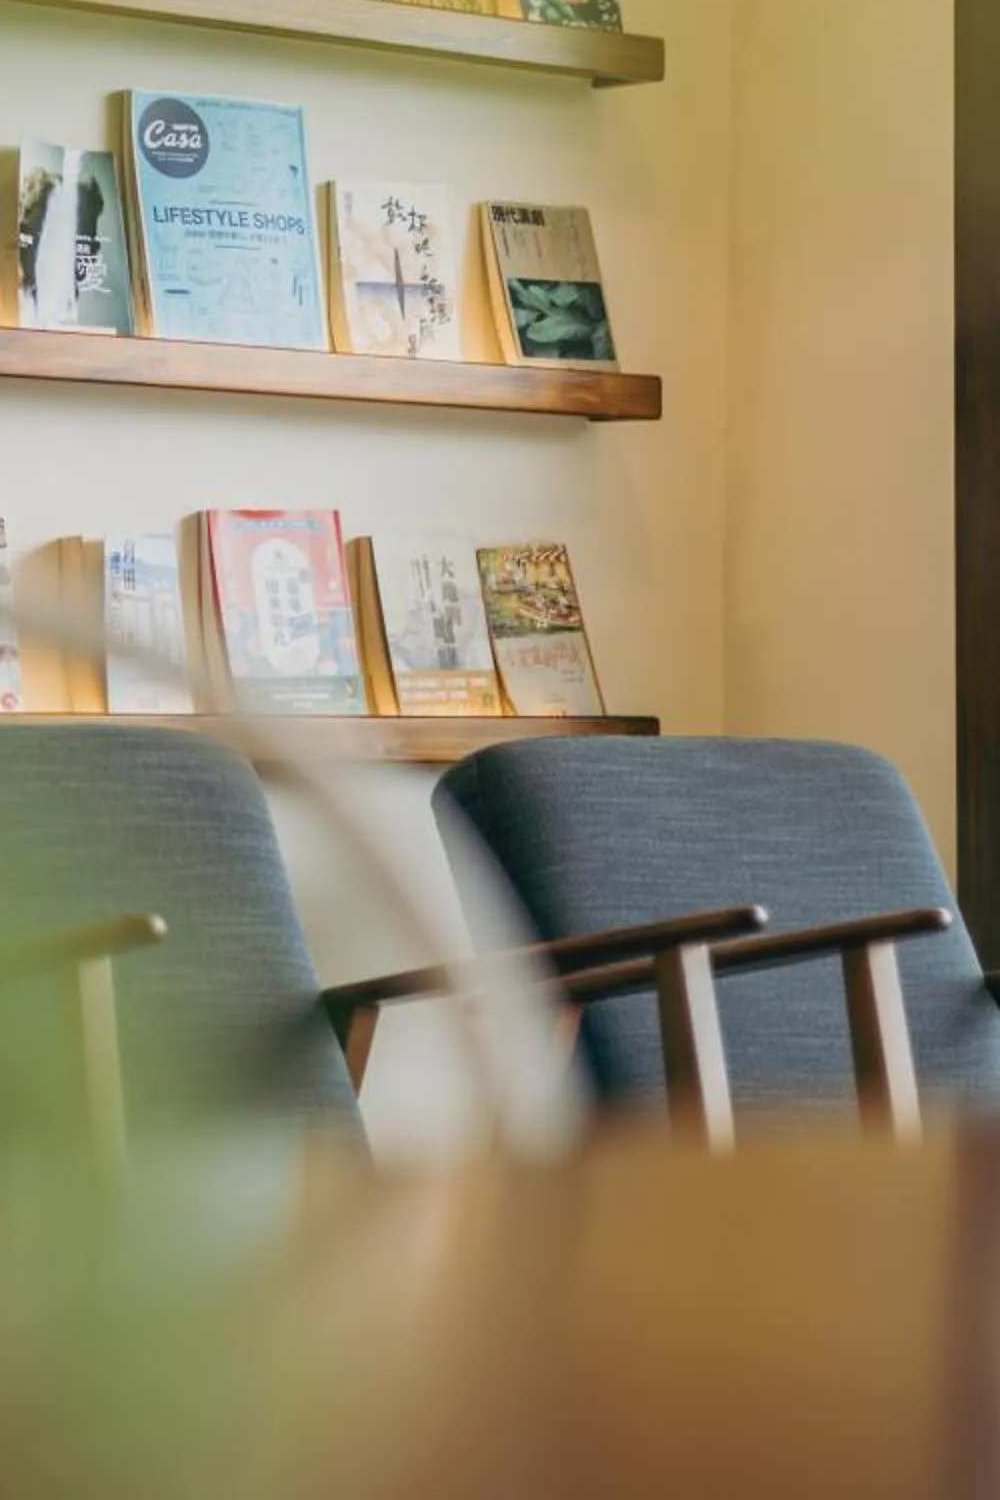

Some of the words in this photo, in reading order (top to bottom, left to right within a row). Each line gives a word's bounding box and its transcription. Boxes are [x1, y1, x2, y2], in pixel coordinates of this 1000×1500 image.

[143, 119, 203, 148] Casa
[152, 205, 249, 228] LIFESTYLE
[252, 211, 305, 235] SHOPS
